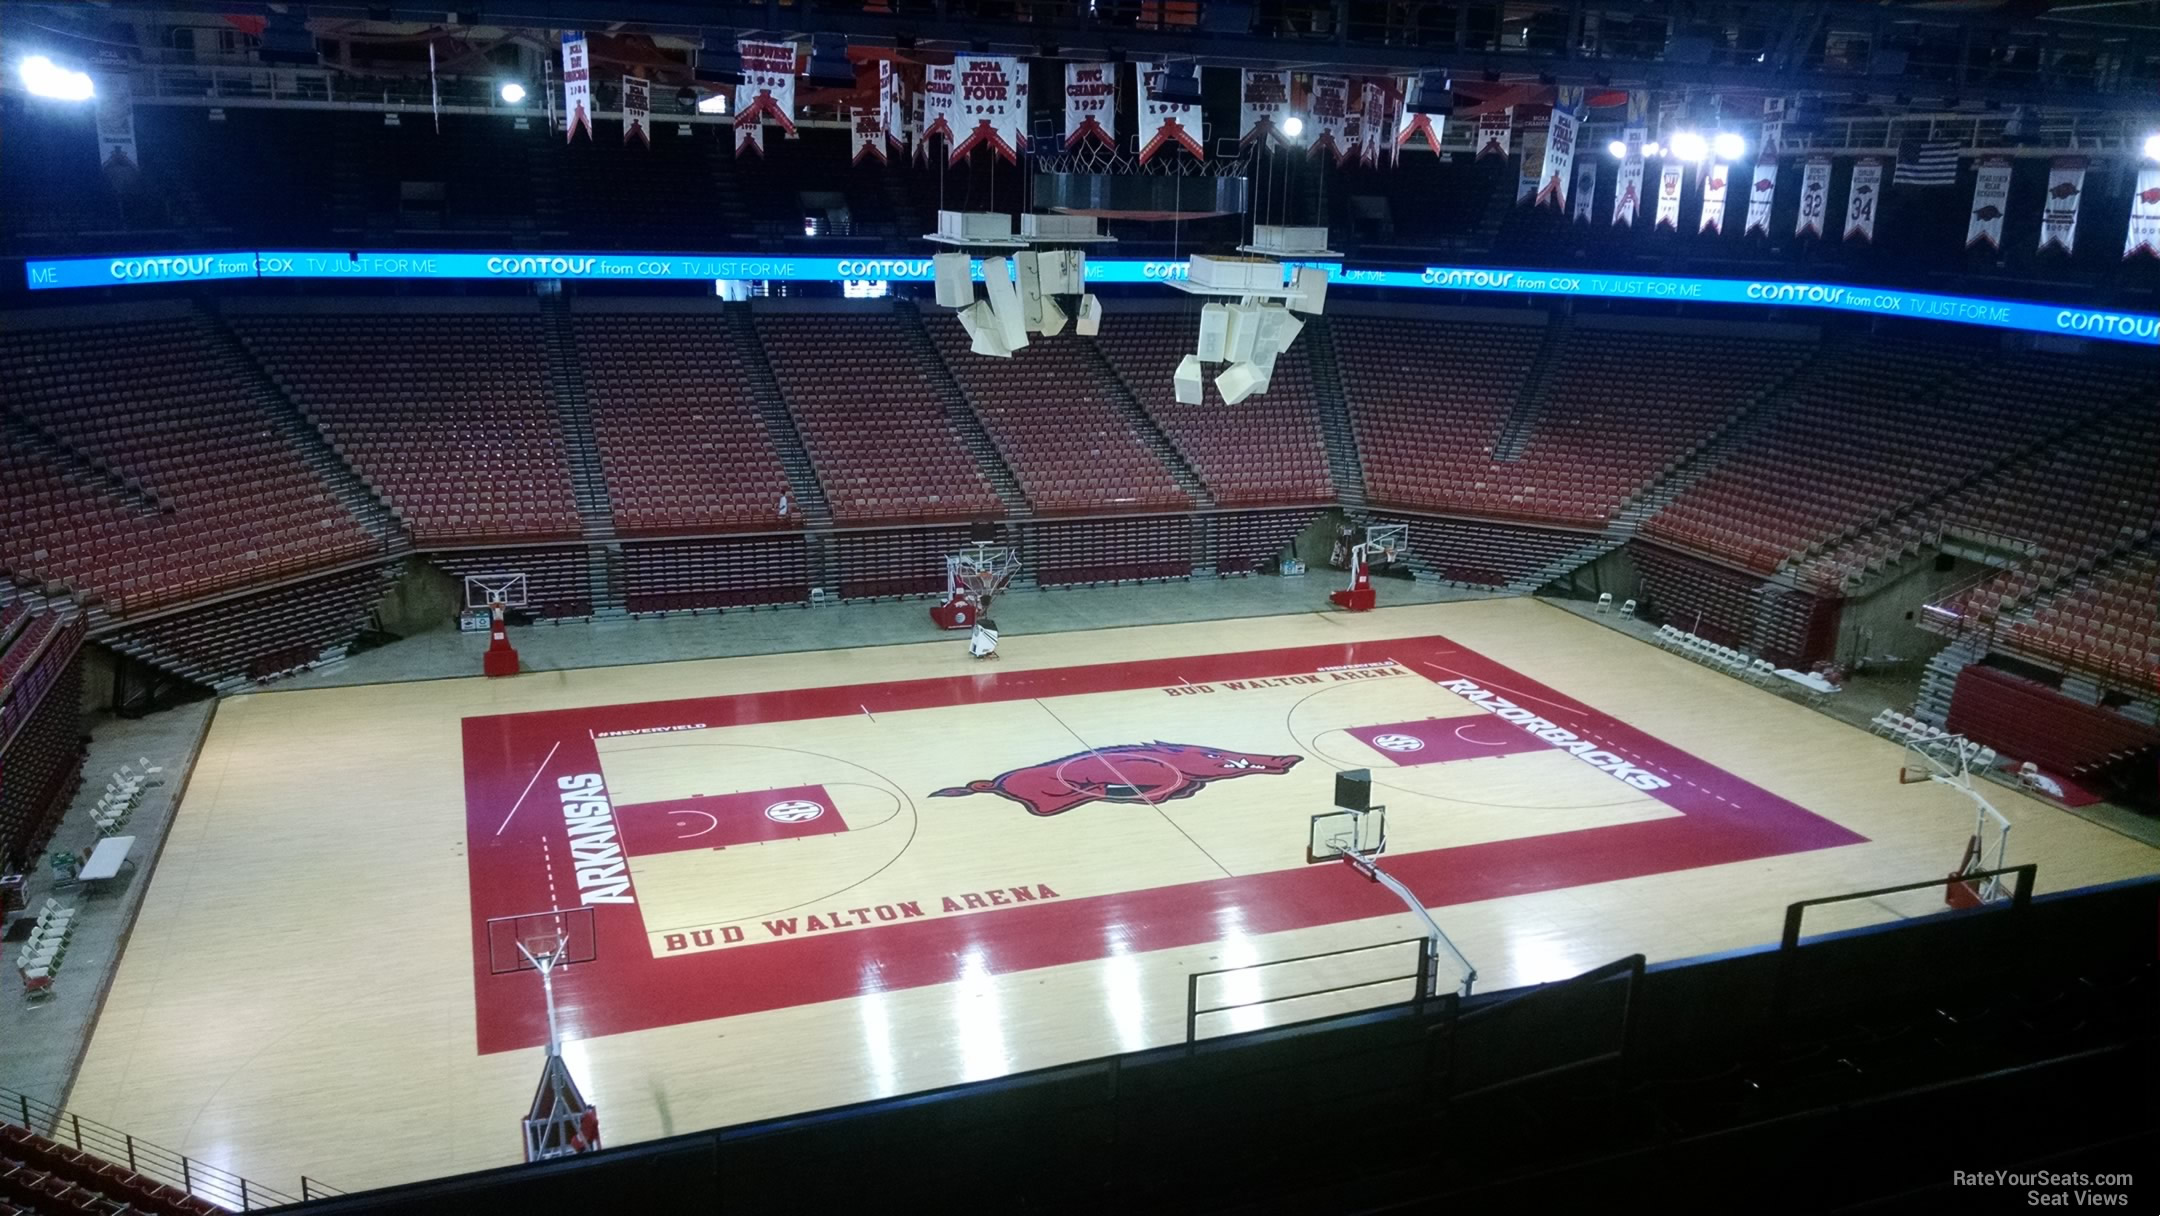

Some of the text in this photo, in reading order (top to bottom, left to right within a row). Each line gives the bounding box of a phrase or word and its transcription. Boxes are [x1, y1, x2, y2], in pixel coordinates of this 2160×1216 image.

[969, 61, 1002, 71] NCAA
[961, 73, 1010, 86] FINAL
[1077, 70, 1102, 82] SWC
[963, 87, 1008, 100] FOUR
[1067, 84, 1113, 96] CHAMPS
[966, 105, 1005, 114] 1941
[1074, 100, 1105, 110] 1927
[1149, 104, 1191, 114] 1990
[1803, 195, 1822, 217] 32
[1851, 197, 1872, 221] 34
[218, 258, 248, 274] from
[253, 257, 294, 272] COX
[306, 258, 327, 273] TV
[331, 258, 371, 273] JUST
[375, 259, 408, 273] FOR
[412, 260, 437, 273] ME
[600, 257, 633, 274] from
[638, 261, 671, 275] COX
[682, 262, 700, 275] TV
[704, 263, 737, 276] JUST
[741, 263, 772, 276] FOR
[774, 263, 795, 276] ME
[1085, 265, 1104, 278] ME
[32, 267, 58, 284] ME
[1367, 270, 1386, 281] ME
[1517, 277, 1545, 289] from
[1550, 278, 1580, 291] COX
[1592, 280, 1608, 291] TV
[1611, 281, 1644, 294] JUST
[1648, 283, 1676, 296] FOR
[1680, 284, 1701, 297] ME
[1847, 293, 1871, 308] from
[1874, 295, 1901, 310] COX
[1910, 299, 1926, 312] TV
[1927, 301, 1957, 315] JUST
[1959, 304, 1987, 319] FOR
[1989, 307, 2010, 322] ME
[1163, 667, 1408, 697] BUD WALTON ARENA
[598, 723, 707, 737] #NEVERYIELD
[1437, 678, 1672, 790] RAZORBACKS
[557, 773, 635, 906] ARKANSAS
[664, 883, 1060, 951] BUD WALTON ARENA
